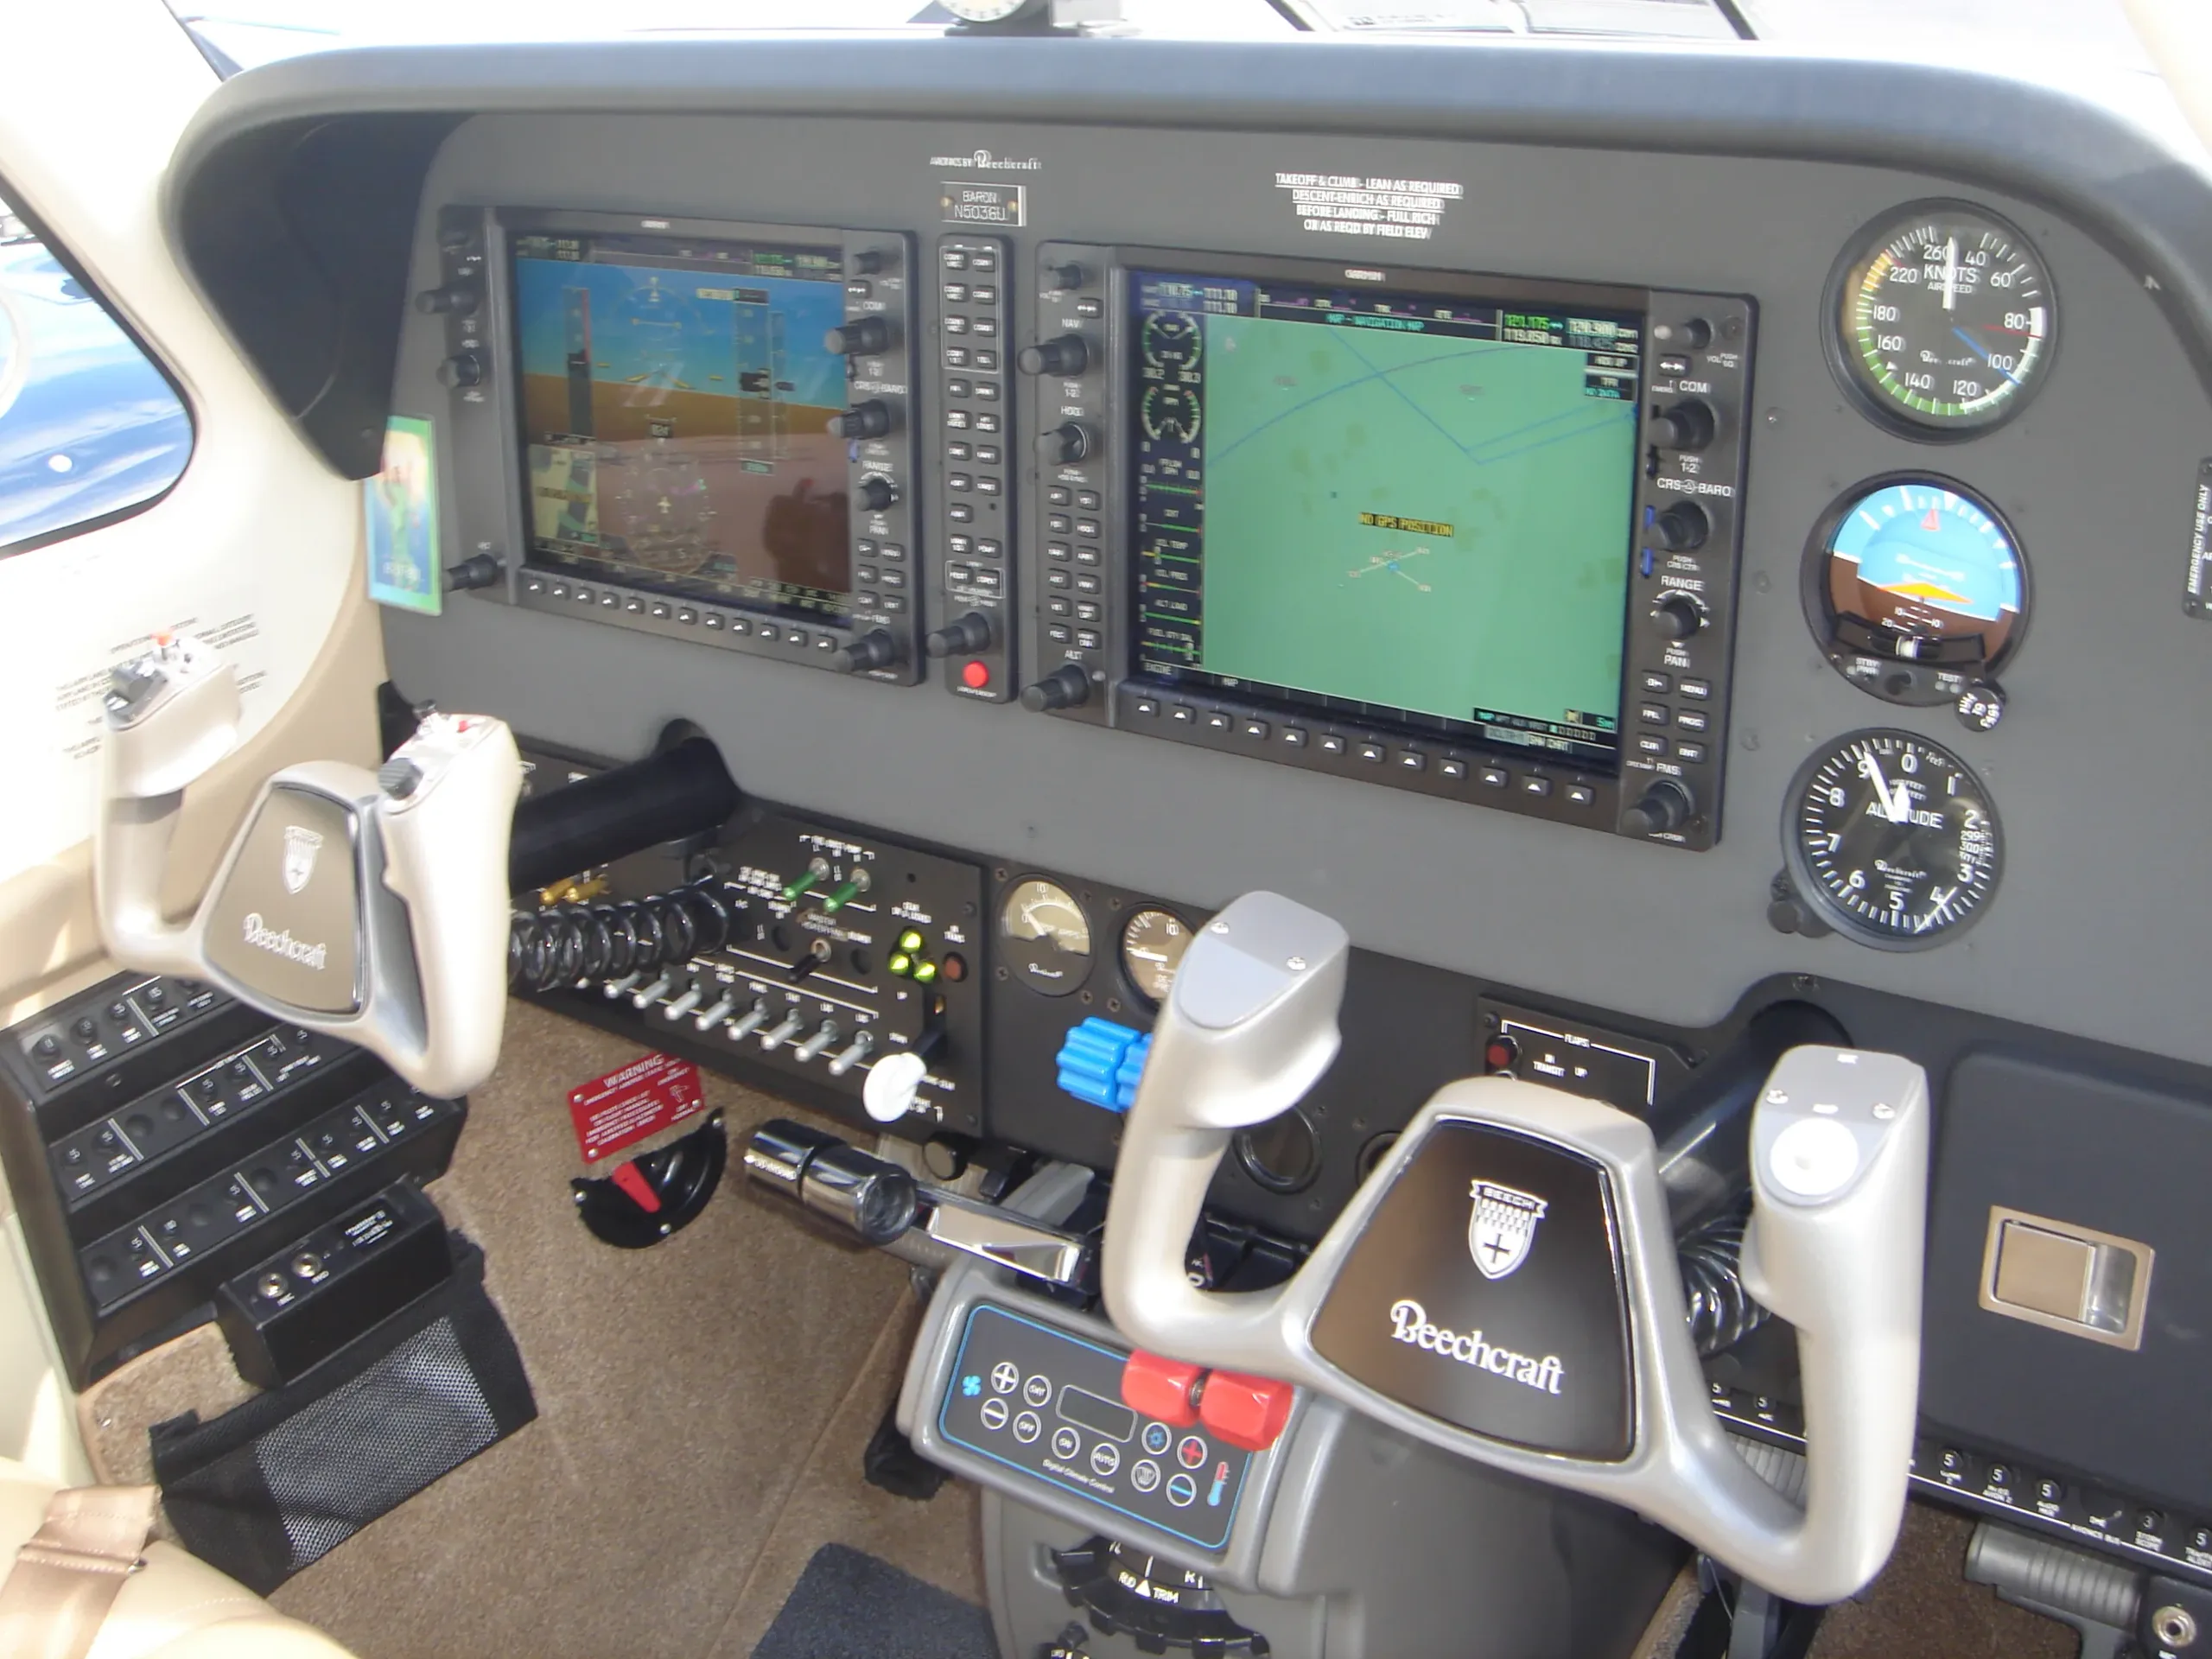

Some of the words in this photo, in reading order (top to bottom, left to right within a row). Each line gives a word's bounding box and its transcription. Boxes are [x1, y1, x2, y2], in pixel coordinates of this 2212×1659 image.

[974, 149, 1041, 169] Beechcraft
[1275, 173, 1317, 186] TAKEOFF
[1318, 176, 1328, 186] &
[1328, 176, 1360, 188] CLIMB
[1365, 178, 1392, 190] LEAN
[1393, 180, 1407, 191] AS
[1408, 181, 1463, 195] REQUIRED
[962, 191, 1000, 203] BARON
[1376, 194, 1389, 206] AS
[1389, 196, 1444, 210] REQUIRED
[1296, 204, 1333, 217] BEFORE
[1333, 207, 1382, 221] LANDING
[1387, 210, 1411, 223] FULL
[1412, 213, 1439, 226] RICH
[1319, 220, 1332, 232] AS
[1363, 224, 1376, 235] BY
[1376, 225, 1404, 238] FIELD
[1404, 226, 1432, 239] ELEV
[1923, 245, 1949, 260] 260
[1965, 251, 1987, 266] 40
[1890, 267, 1919, 283] 220
[1990, 273, 2012, 288] 60
[1928, 283, 1975, 294] AIREED
[1873, 305, 1897, 321] 180
[2004, 313, 2026, 330] 80
[1062, 319, 1084, 328] NAV
[1352, 315, 1407, 329] NAVIGATION
[1878, 335, 1904, 351] 160
[1987, 354, 2013, 371] 100
[1679, 381, 1711, 393] COM
[1904, 372, 1932, 390] 140
[1953, 379, 1980, 397] 120
[1681, 463, 1700, 474] 1-2
[1656, 477, 1681, 490] CRS
[1698, 483, 1736, 498] BARO
[2197, 484, 2210, 511] ONLY
[1360, 513, 1375, 524] NO
[1376, 515, 1398, 528] GPS
[1399, 519, 1453, 537] POSITION
[1661, 575, 1706, 591] RANGE
[1663, 656, 1690, 669] PAN
[1937, 672, 1963, 683] TEST
[1681, 683, 1708, 696] MENU
[1656, 762, 1682, 776] FMS
[1857, 760, 1872, 779] 9
[1901, 753, 1917, 773] 0
[1947, 773, 1957, 796] 1
[1829, 787, 1845, 808] 8
[1866, 801, 1944, 830] ALUDE
[1963, 809, 1980, 830] 2
[1827, 832, 1842, 853] 7
[1848, 869, 1866, 889] 6
[1957, 863, 1974, 884] 3
[1889, 891, 1904, 912] 5
[1929, 886, 1945, 906] 4
[243, 912, 327, 971] Beechcraft
[1564, 1033, 1591, 1049] FLAPS
[603, 1053, 665, 1089] WARNING
[1482, 1185, 1536, 1211] BEECH
[1389, 1300, 1566, 1395] Beechcraft
[1092, 1452, 1116, 1467] AUTO
[1944, 1453, 1955, 1467] 5
[1042, 1458, 1065, 1475] Digital
[1088, 1477, 1116, 1494] Control
[1992, 1468, 2004, 1483] 5
[2041, 1484, 2053, 1498] 5
[2195, 1530, 2208, 1546] 5
